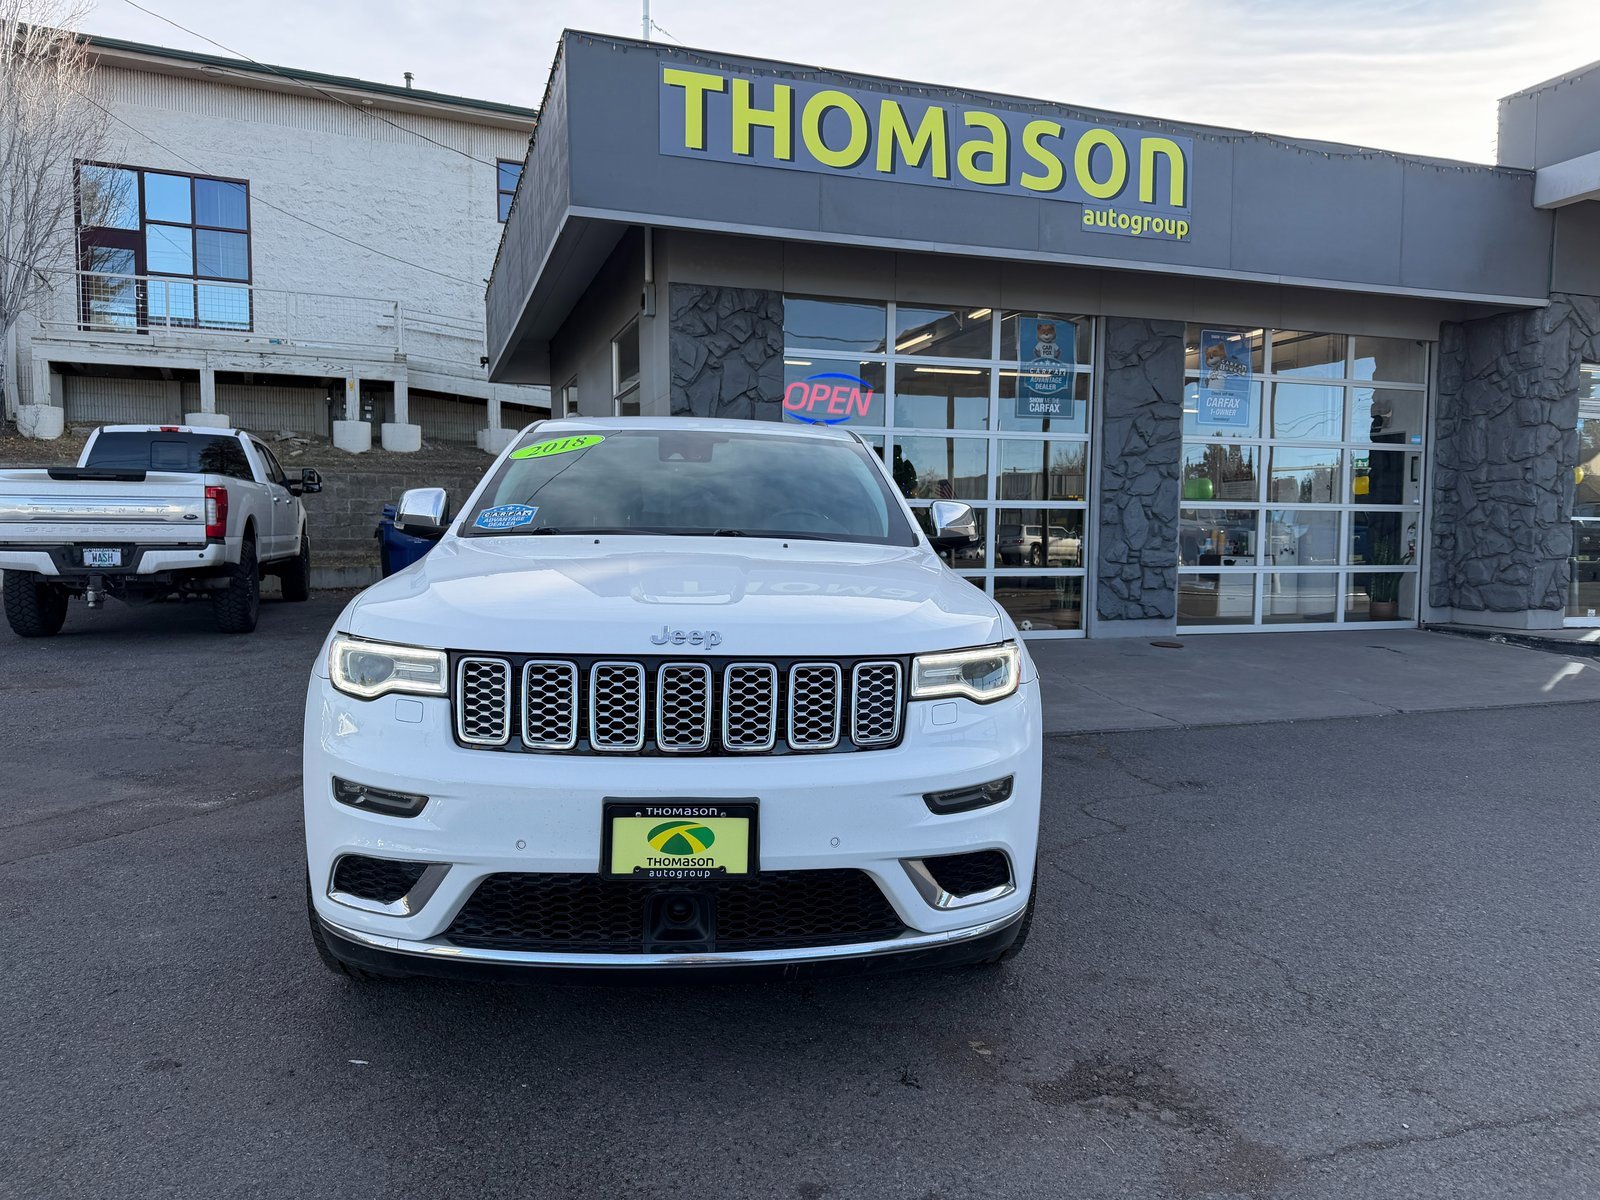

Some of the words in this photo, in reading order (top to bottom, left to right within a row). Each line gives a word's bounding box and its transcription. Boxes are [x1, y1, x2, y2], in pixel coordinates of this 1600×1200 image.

[1083, 207, 1189, 240] autogroup
[783, 381, 873, 417] OPEN
[1206, 397, 1240, 409] CARFAX
[1029, 403, 1060, 413] CARFAX
[1210, 408, 1237, 416] 1-OWNER
[527, 437, 588, 457] 2018
[91, 552, 113, 563] WASH
[650, 625, 722, 650] Jeep
[649, 869, 711, 879] autogroup
